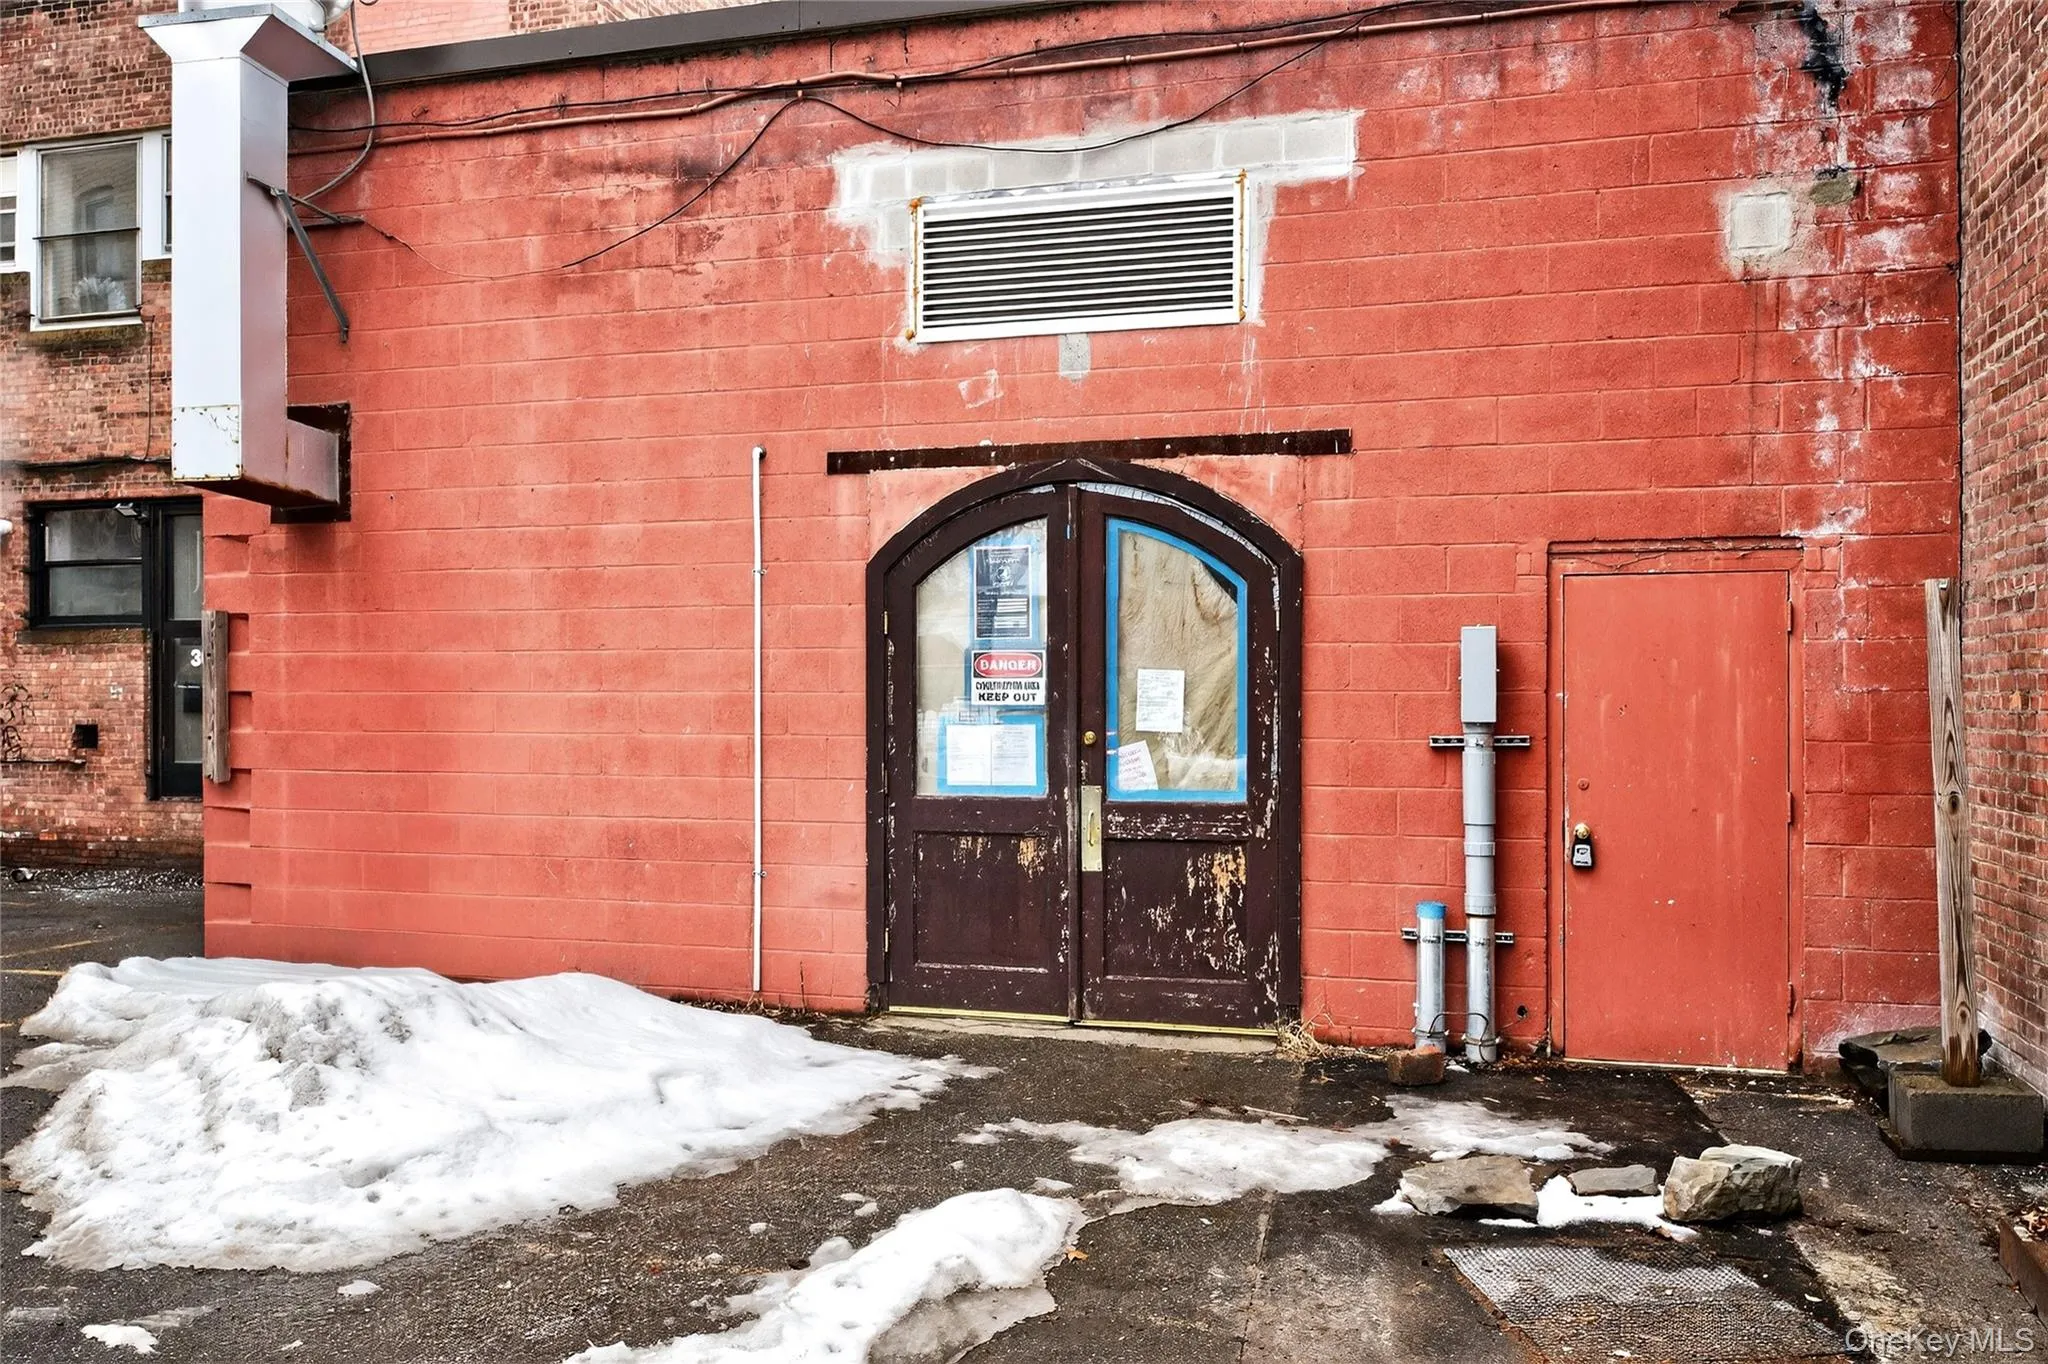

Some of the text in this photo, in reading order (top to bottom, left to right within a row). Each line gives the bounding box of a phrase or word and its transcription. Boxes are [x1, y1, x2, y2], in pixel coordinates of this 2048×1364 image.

[190, 648, 203, 667] 3
[979, 659, 1037, 671] DANGER
[978, 692, 1037, 702] KEEP OUT
